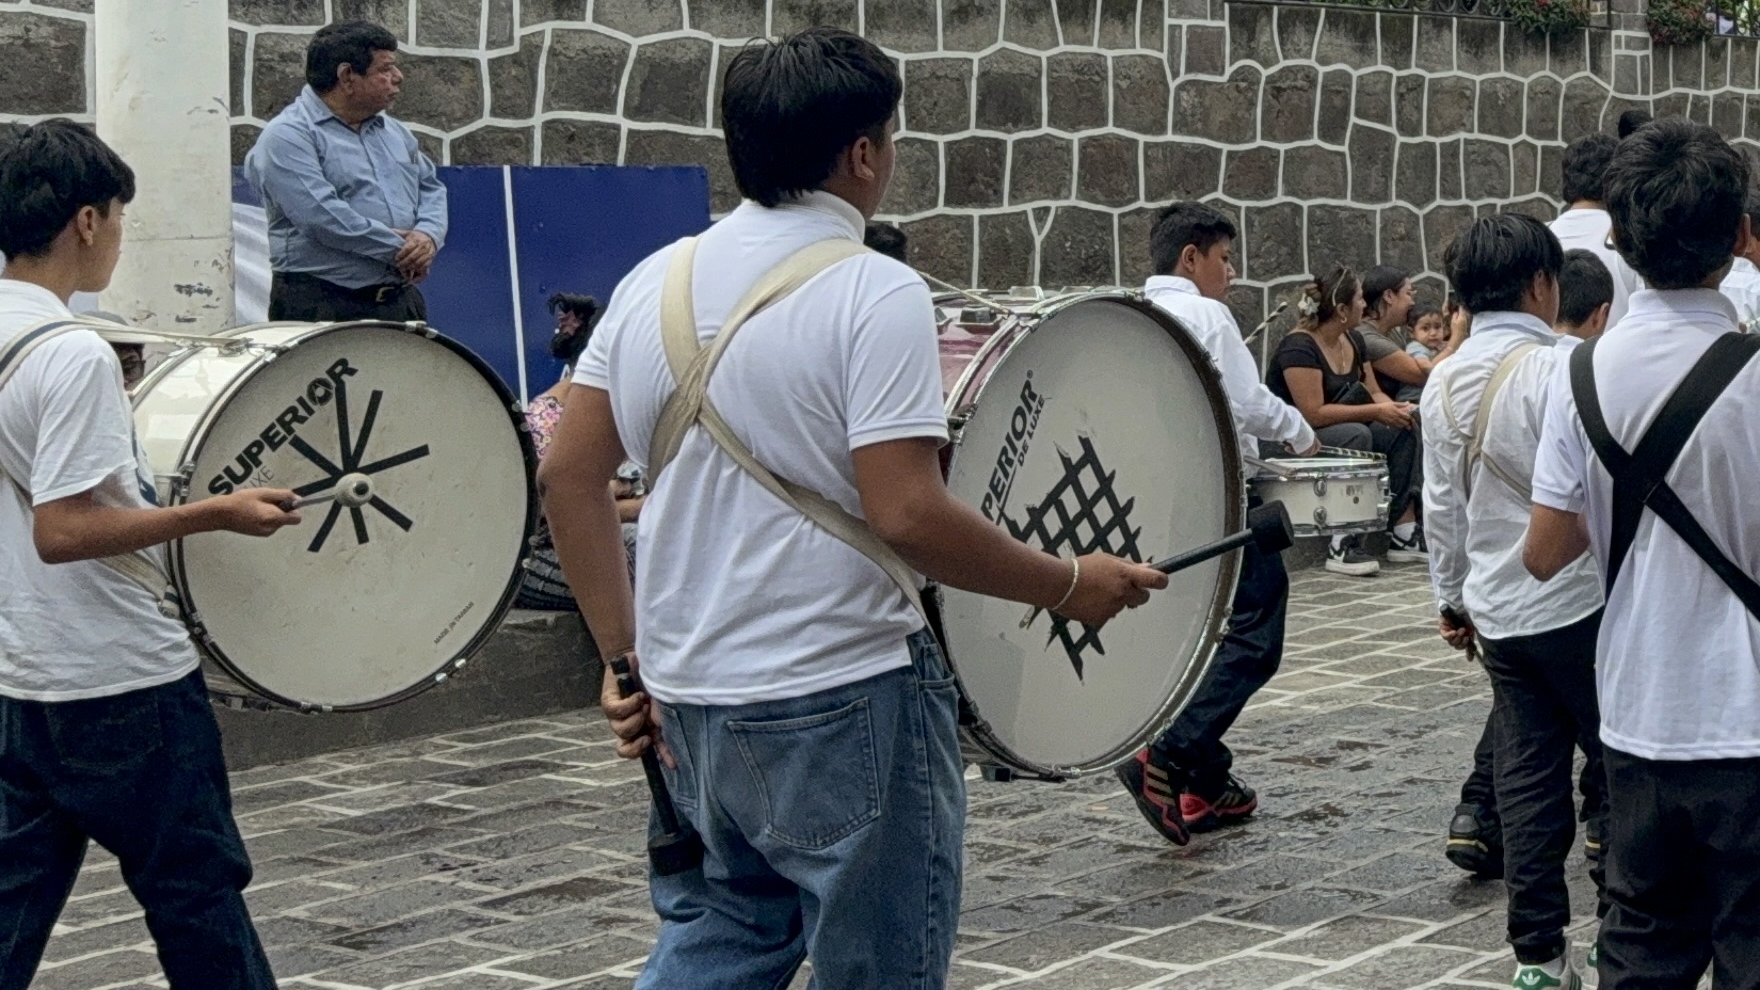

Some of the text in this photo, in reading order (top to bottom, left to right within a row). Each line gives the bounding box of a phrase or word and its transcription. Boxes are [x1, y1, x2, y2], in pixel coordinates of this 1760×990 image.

[208, 357, 359, 495] SUPERIOR
[980, 379, 1038, 522] PERIOR
[1017, 394, 1045, 467] DE LUXE
